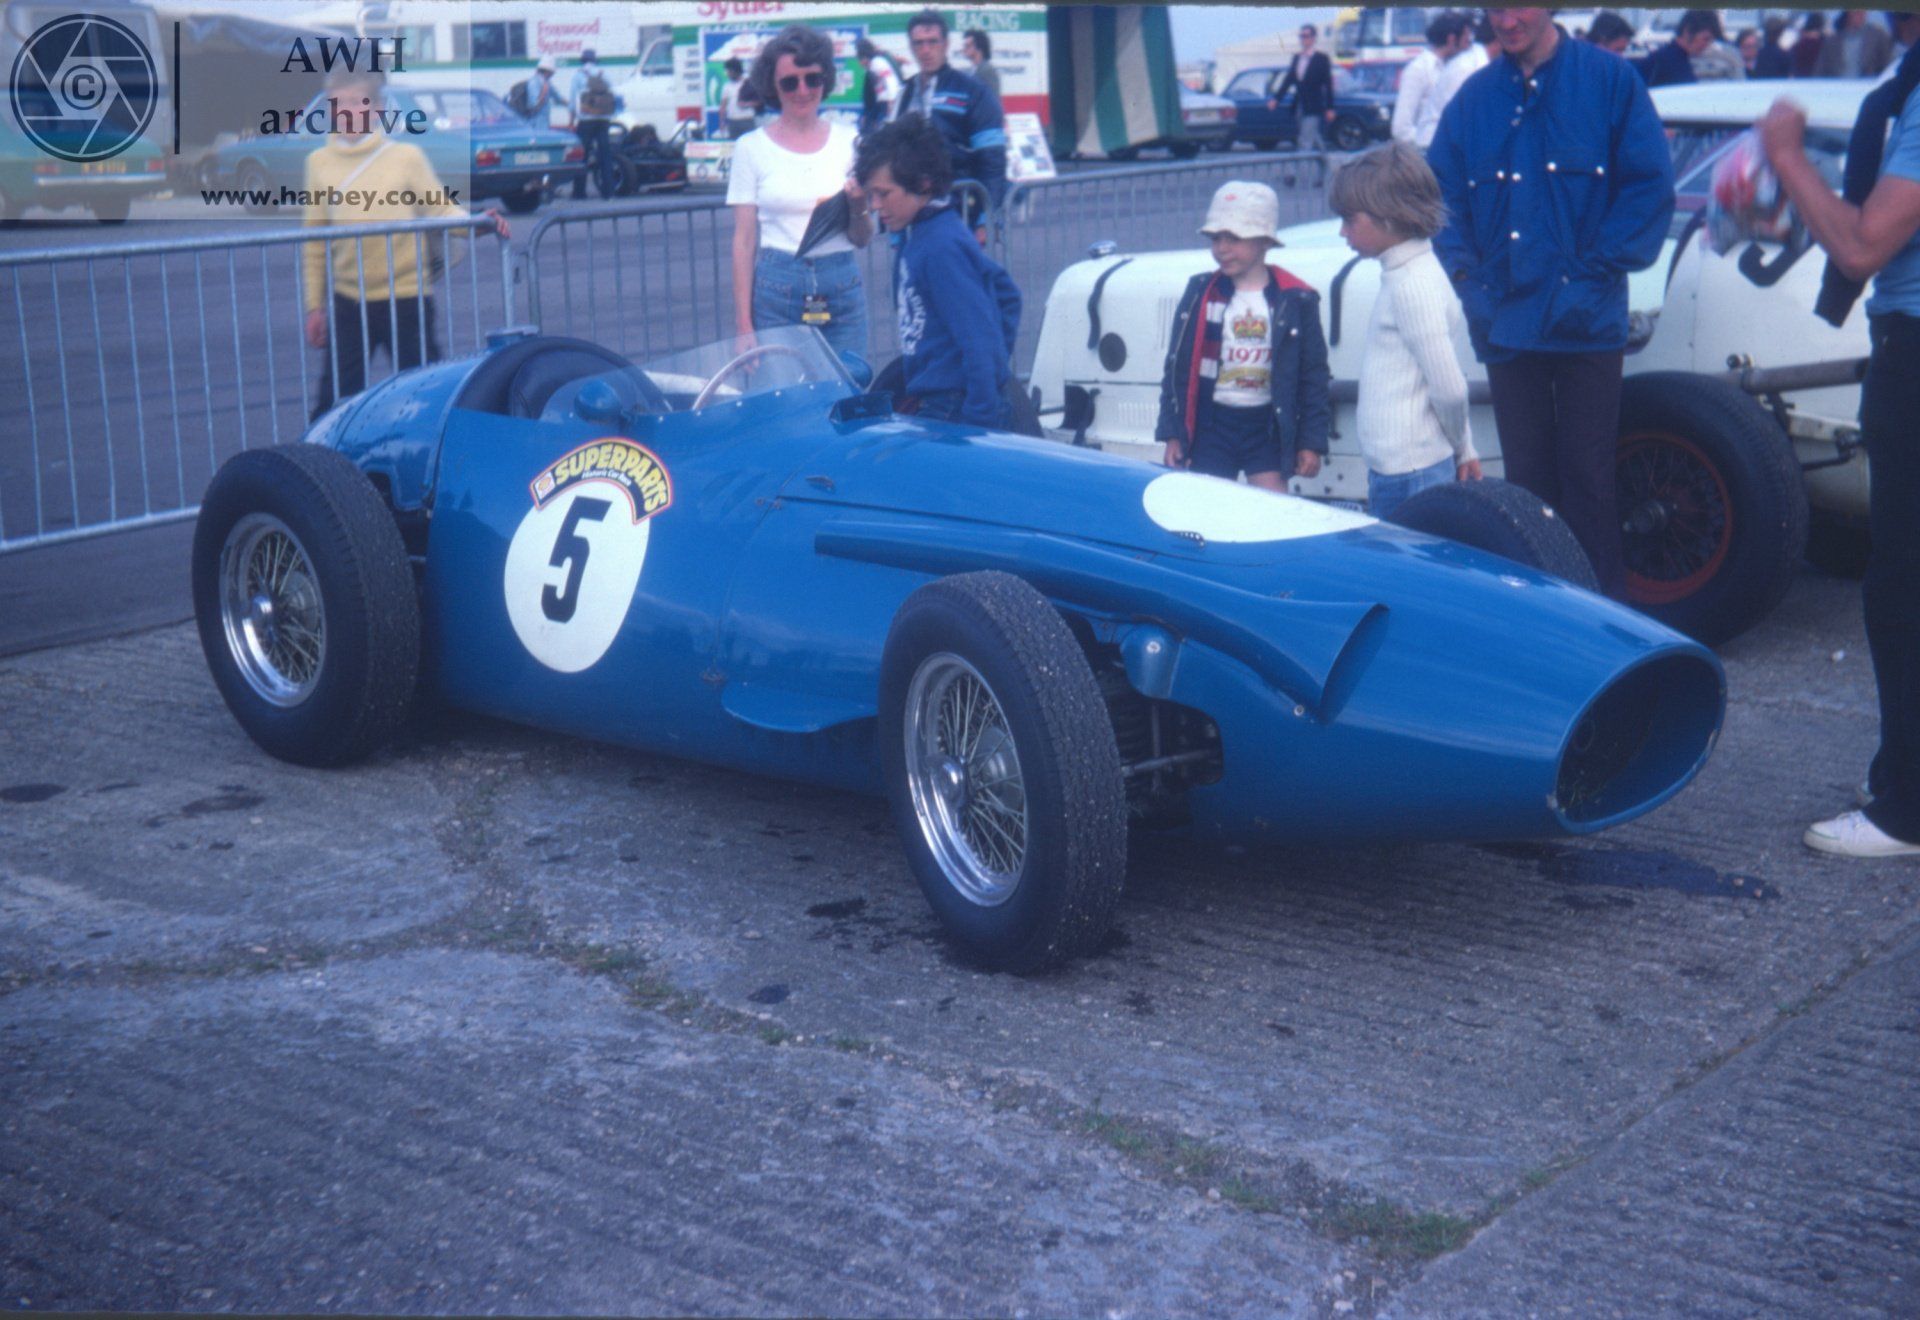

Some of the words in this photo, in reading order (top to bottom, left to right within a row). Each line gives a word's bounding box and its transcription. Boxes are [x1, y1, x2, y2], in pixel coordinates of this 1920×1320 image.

[955, 11, 1020, 30] RACING
[1228, 347, 1273, 364] 1977
[553, 443, 667, 512] SUPERPARTS
[541, 495, 613, 624] 5
